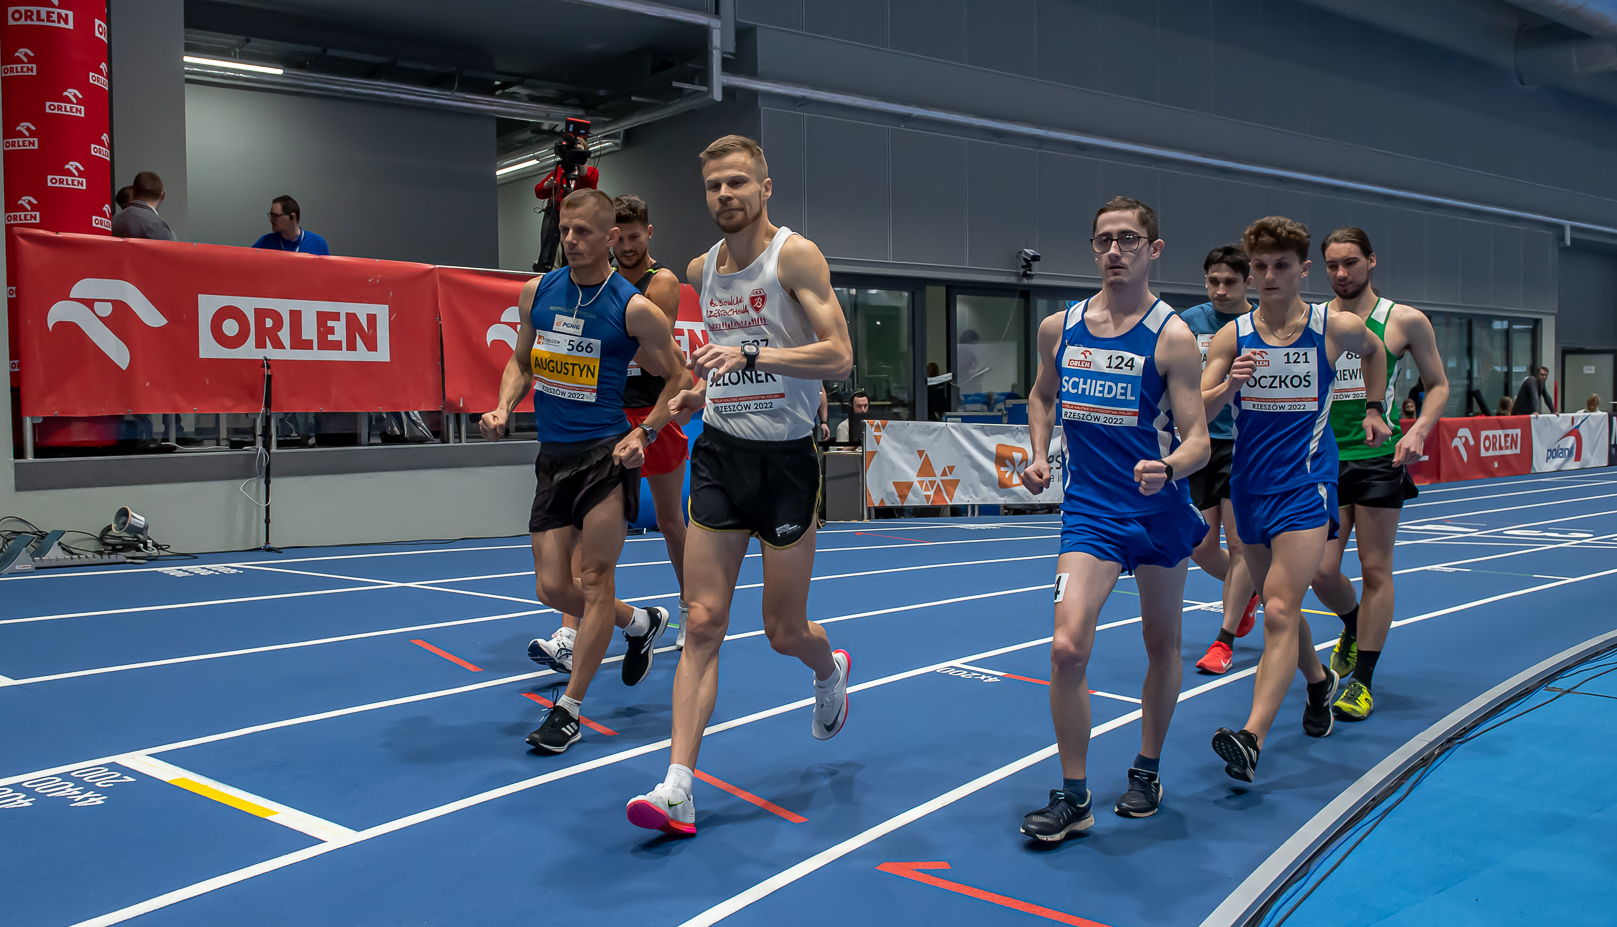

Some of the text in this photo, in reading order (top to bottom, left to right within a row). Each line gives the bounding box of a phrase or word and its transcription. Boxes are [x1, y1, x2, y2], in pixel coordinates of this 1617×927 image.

[11, 9, 70, 25] ORLEN
[3, 66, 34, 75] ORLEN
[91, 74, 108, 87] ORLE
[48, 104, 83, 115] ORLEN
[5, 140, 36, 149] ORLEN
[93, 146, 109, 158] ORLE
[50, 177, 84, 188] ORLEN
[7, 214, 37, 223] ORLEN
[94, 218, 111, 228] ORLE
[210, 304, 378, 353] ORLEN
[567, 340, 594, 354] 566
[1106, 355, 1135, 371] 124
[1283, 352, 1310, 364] 121
[534, 357, 596, 379] AUGUSTYN
[1246, 371, 1312, 389] OCZKOŚ
[1062, 376, 1136, 400] SCHIEDEL
[567, 392, 585, 400] 2022
[754, 402, 774, 410] 2022
[1064, 411, 1124, 425] RZESZÓW 2022
[1483, 433, 1518, 452] ORLEN
[70, 766, 137, 788] 200
